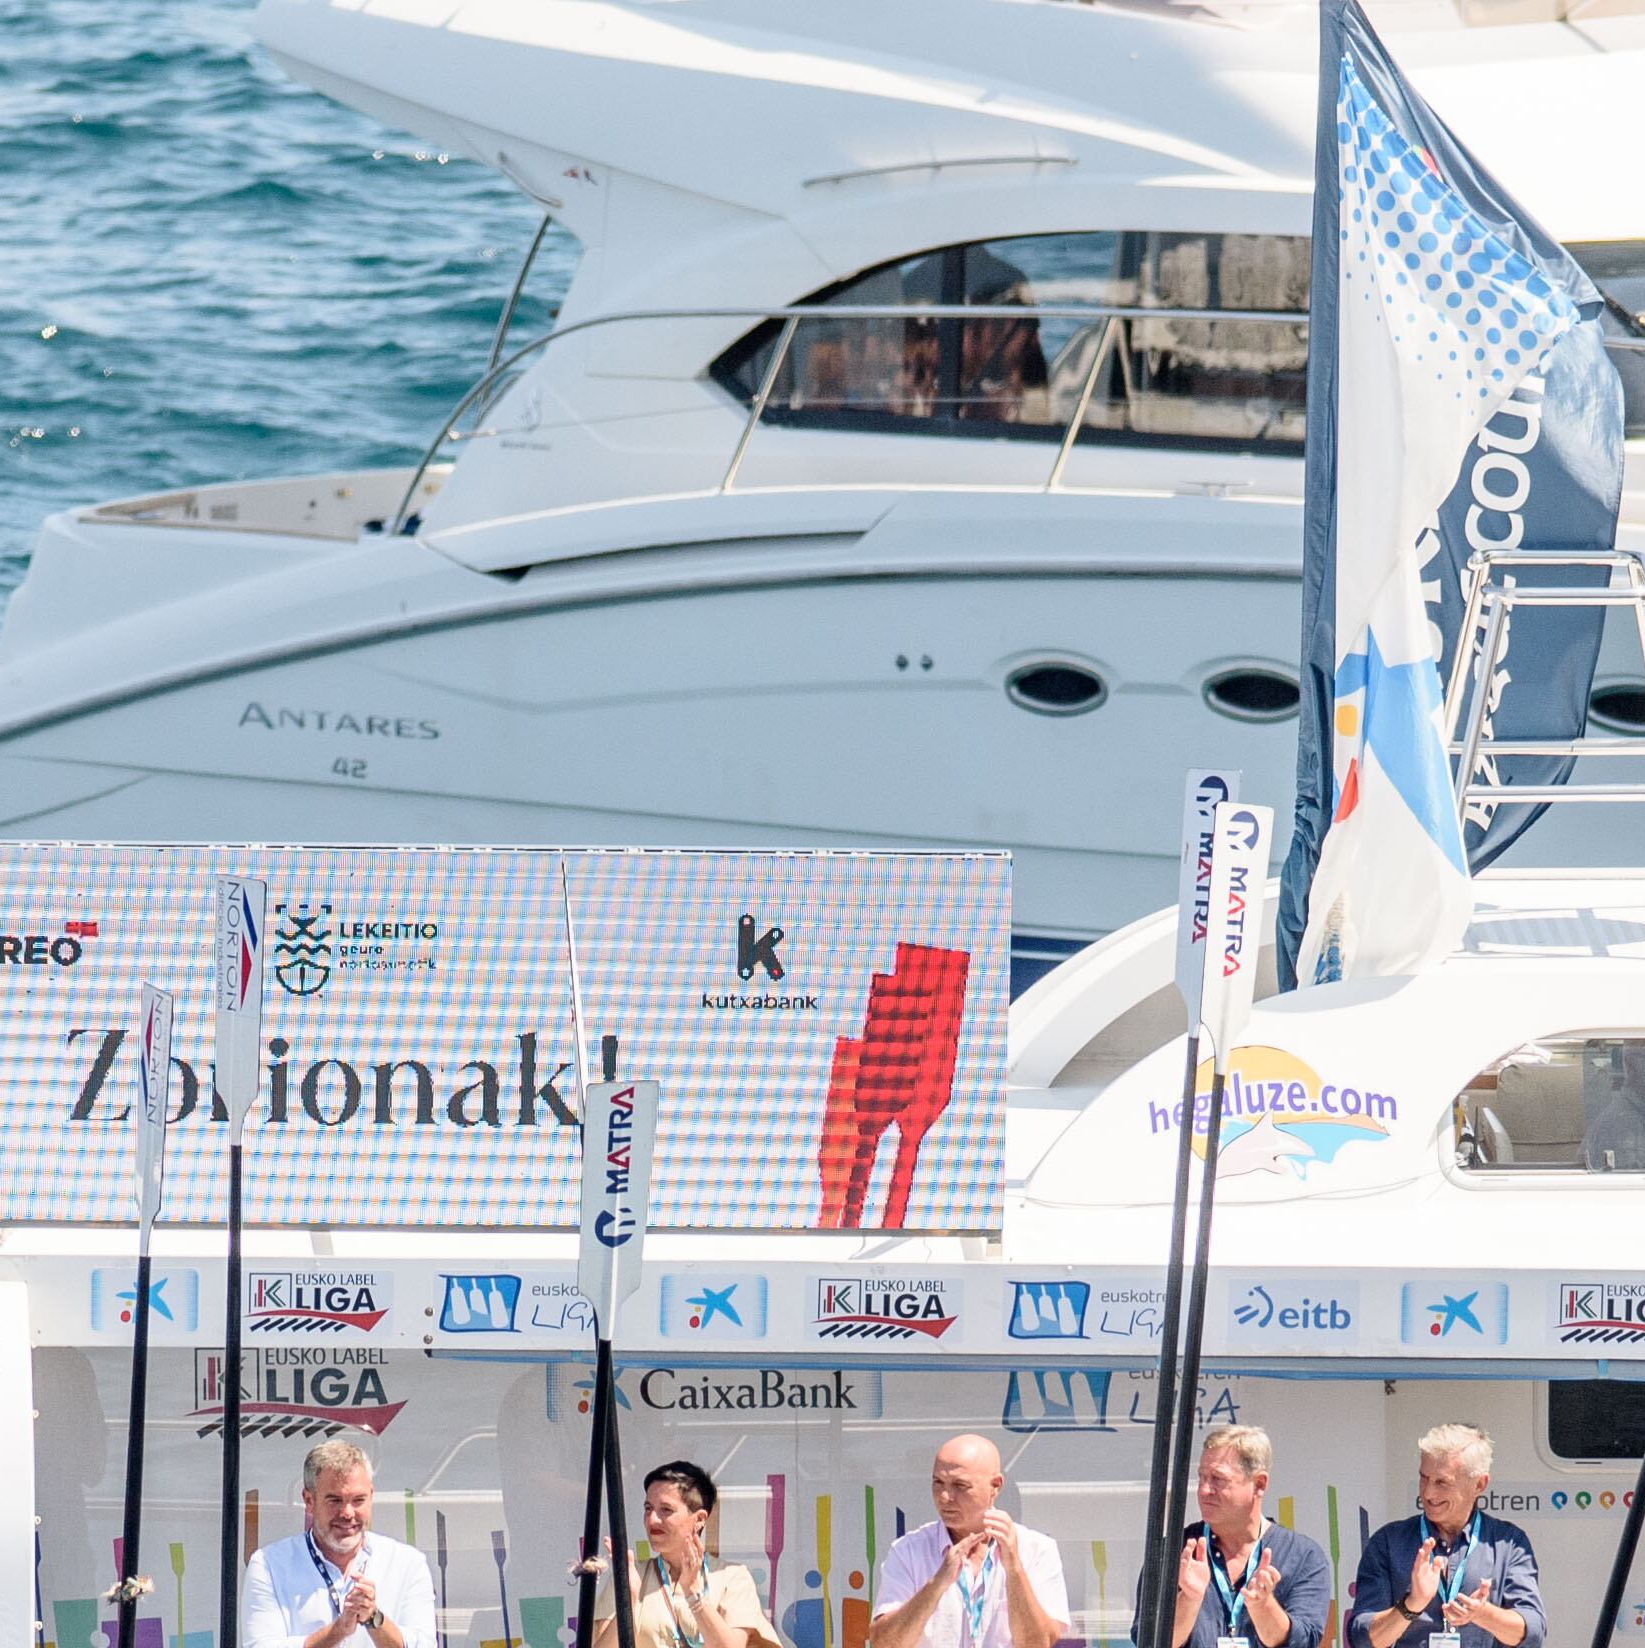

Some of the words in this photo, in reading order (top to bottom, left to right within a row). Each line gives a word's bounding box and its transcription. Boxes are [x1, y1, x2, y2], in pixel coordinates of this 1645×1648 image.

[332, 758, 368, 777] 42
[339, 922, 438, 939] LEKEITIO
[1223, 867, 1249, 977] MATRA
[226, 881, 241, 1012] NORTON
[701, 993, 818, 1010] kutxabank
[147, 993, 165, 1125] NORTON
[606, 1086, 635, 1194] MATRA
[295, 1273, 335, 1286] EUSKO
[339, 1273, 377, 1286] LABEL
[531, 1282, 580, 1297] eusko
[865, 1279, 904, 1293] EUSKO
[909, 1280, 946, 1293] LABEL
[296, 1287, 377, 1314] LIGA
[865, 1293, 946, 1320] LIGA
[1101, 1288, 1167, 1303] euskotr
[531, 1301, 594, 1331] LIG
[1280, 1298, 1352, 1330] eitb
[265, 1348, 326, 1366] EUSKO
[332, 1348, 388, 1366] LABEL
[265, 1367, 387, 1406] LIGA
[639, 1367, 857, 1410] CaixaBank
[1416, 1489, 1539, 1512] eotren
